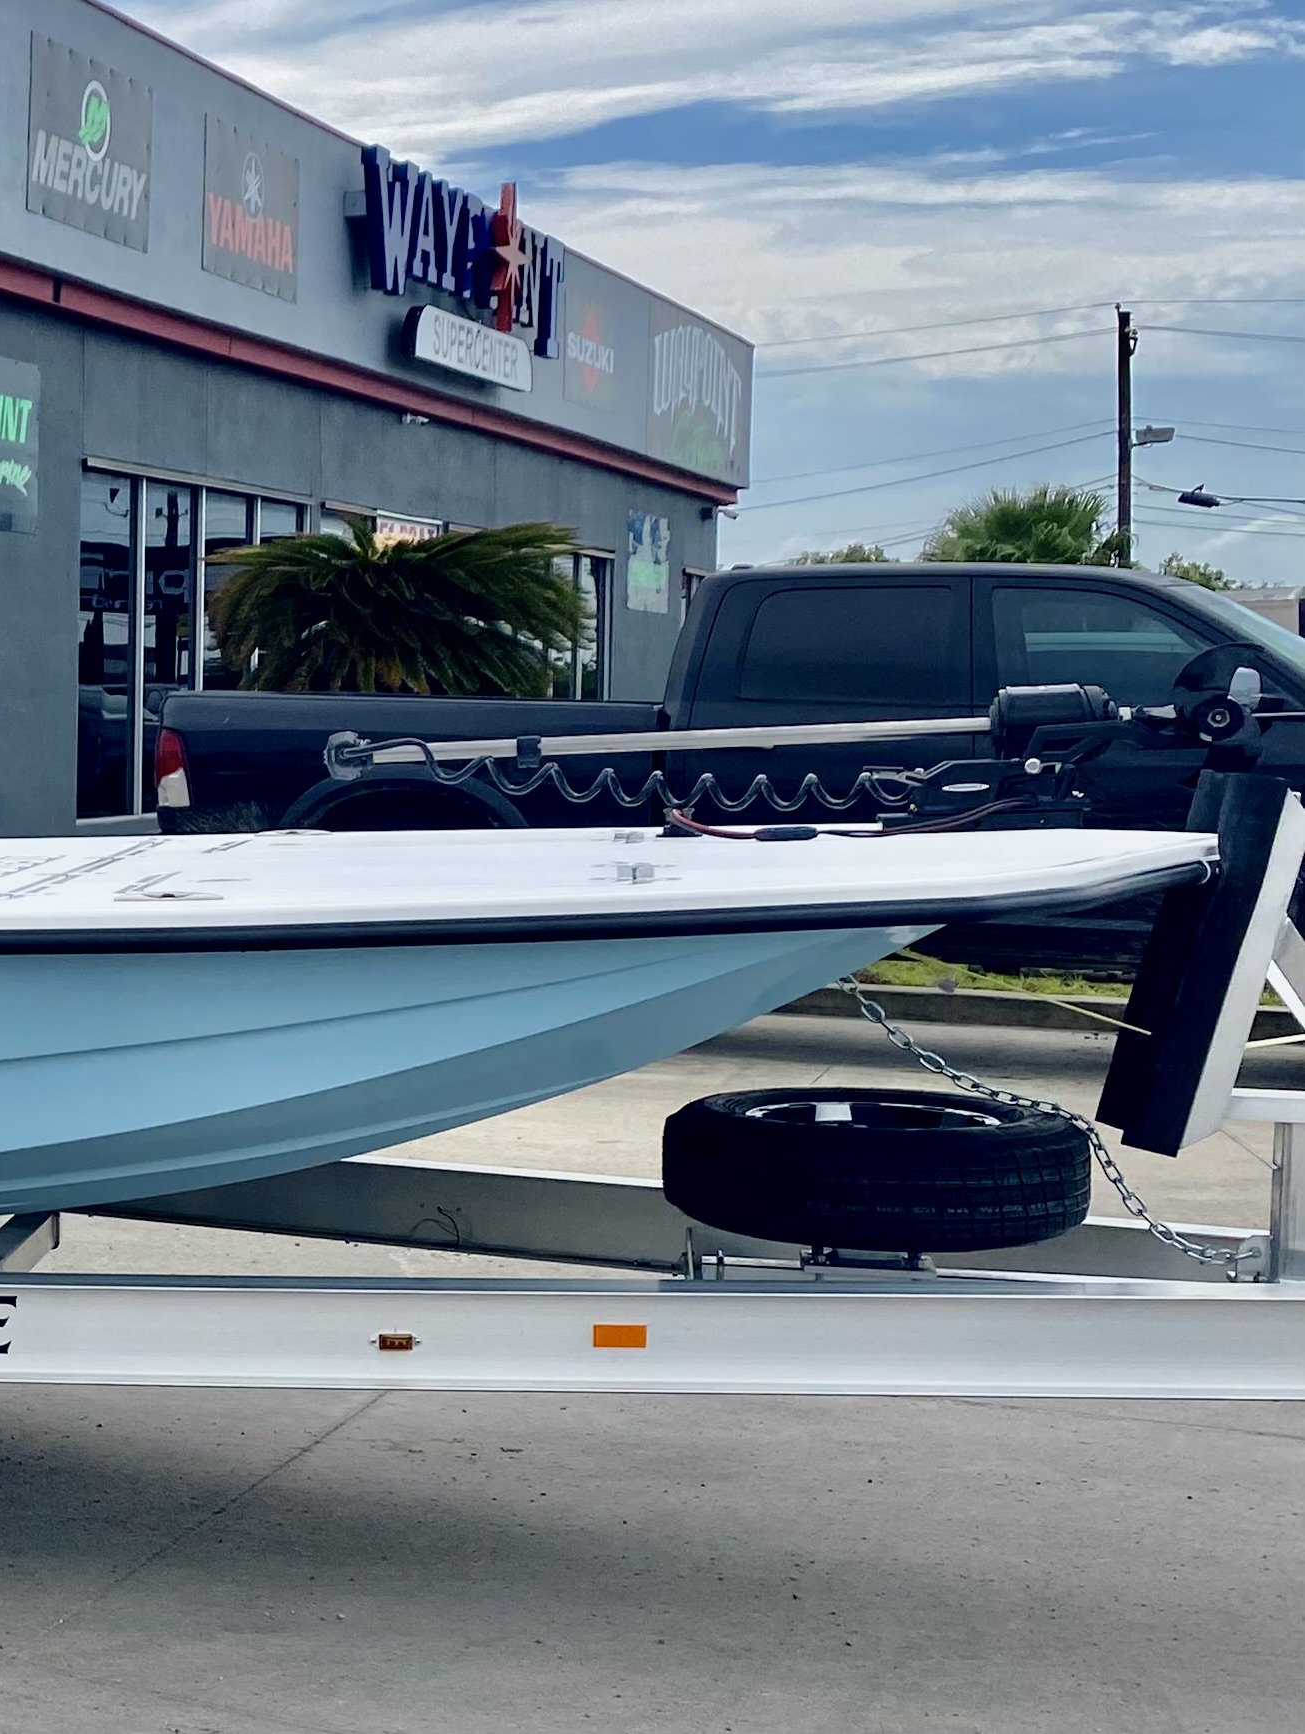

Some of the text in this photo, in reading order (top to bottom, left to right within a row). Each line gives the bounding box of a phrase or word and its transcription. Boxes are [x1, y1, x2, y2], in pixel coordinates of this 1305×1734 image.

[32, 129, 147, 220] MERCURY
[208, 192, 293, 274] YAMAHA
[432, 313, 519, 382] SUPERCENTER
[567, 331, 614, 374] SUZUKI
